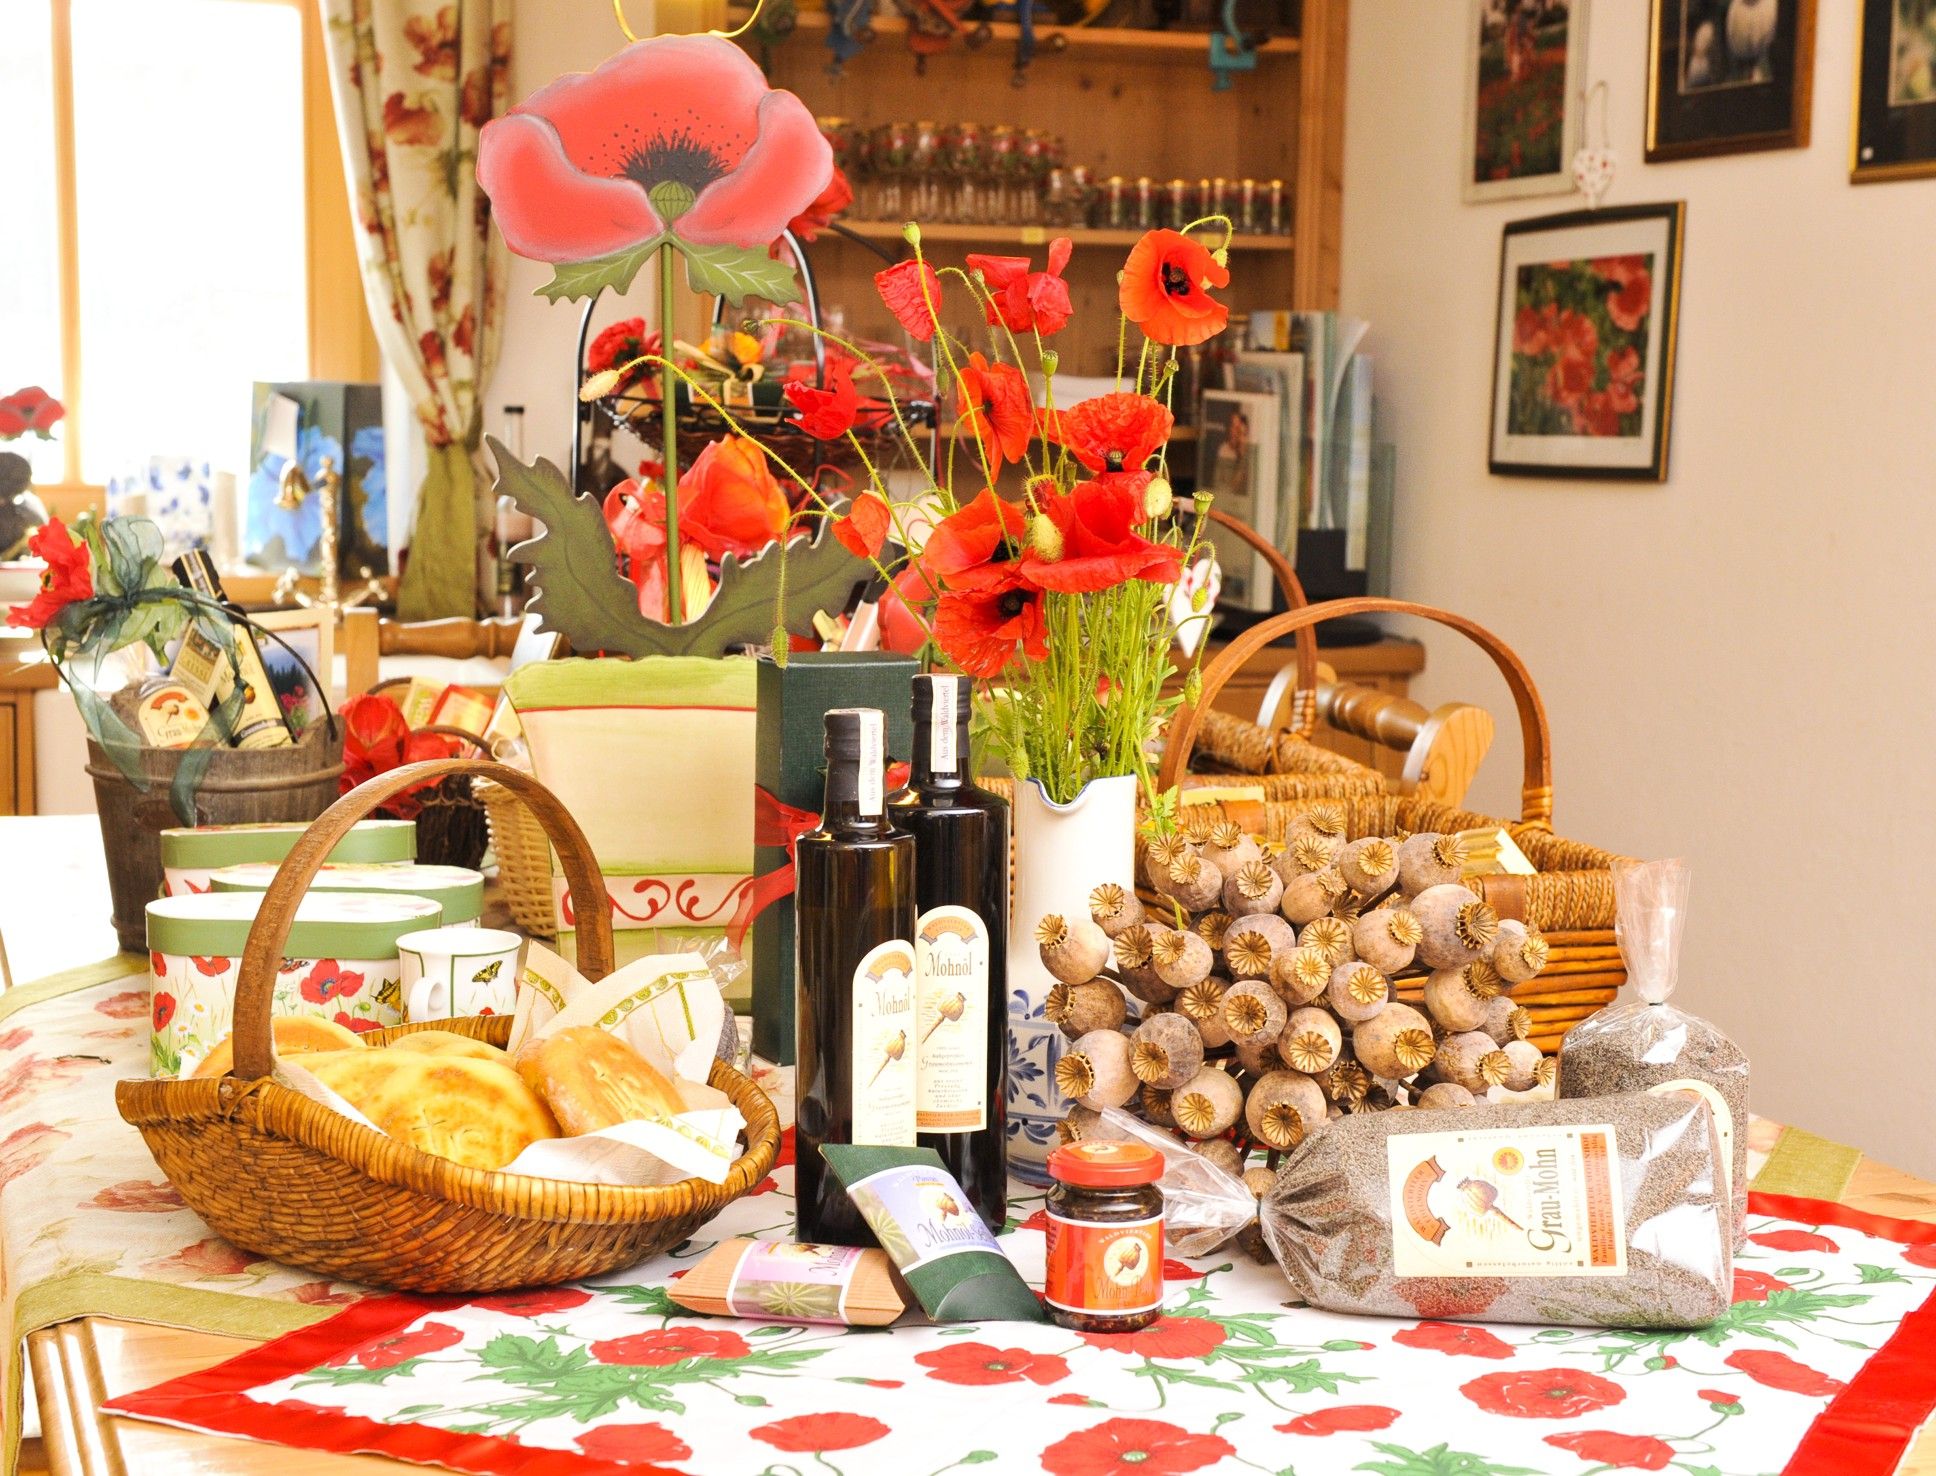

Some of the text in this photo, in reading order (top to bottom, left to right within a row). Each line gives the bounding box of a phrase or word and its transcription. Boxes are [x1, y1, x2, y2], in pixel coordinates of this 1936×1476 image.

[940, 685, 949, 760] Aus dem Waldviertel
[871, 986, 910, 1017] Mohnöl
[925, 951, 972, 977] Mohnöl
[1527, 1148, 1572, 1253] Grau-Mohn
[1583, 1136, 1599, 1263] WALDVIERTLER MOHNHOF
